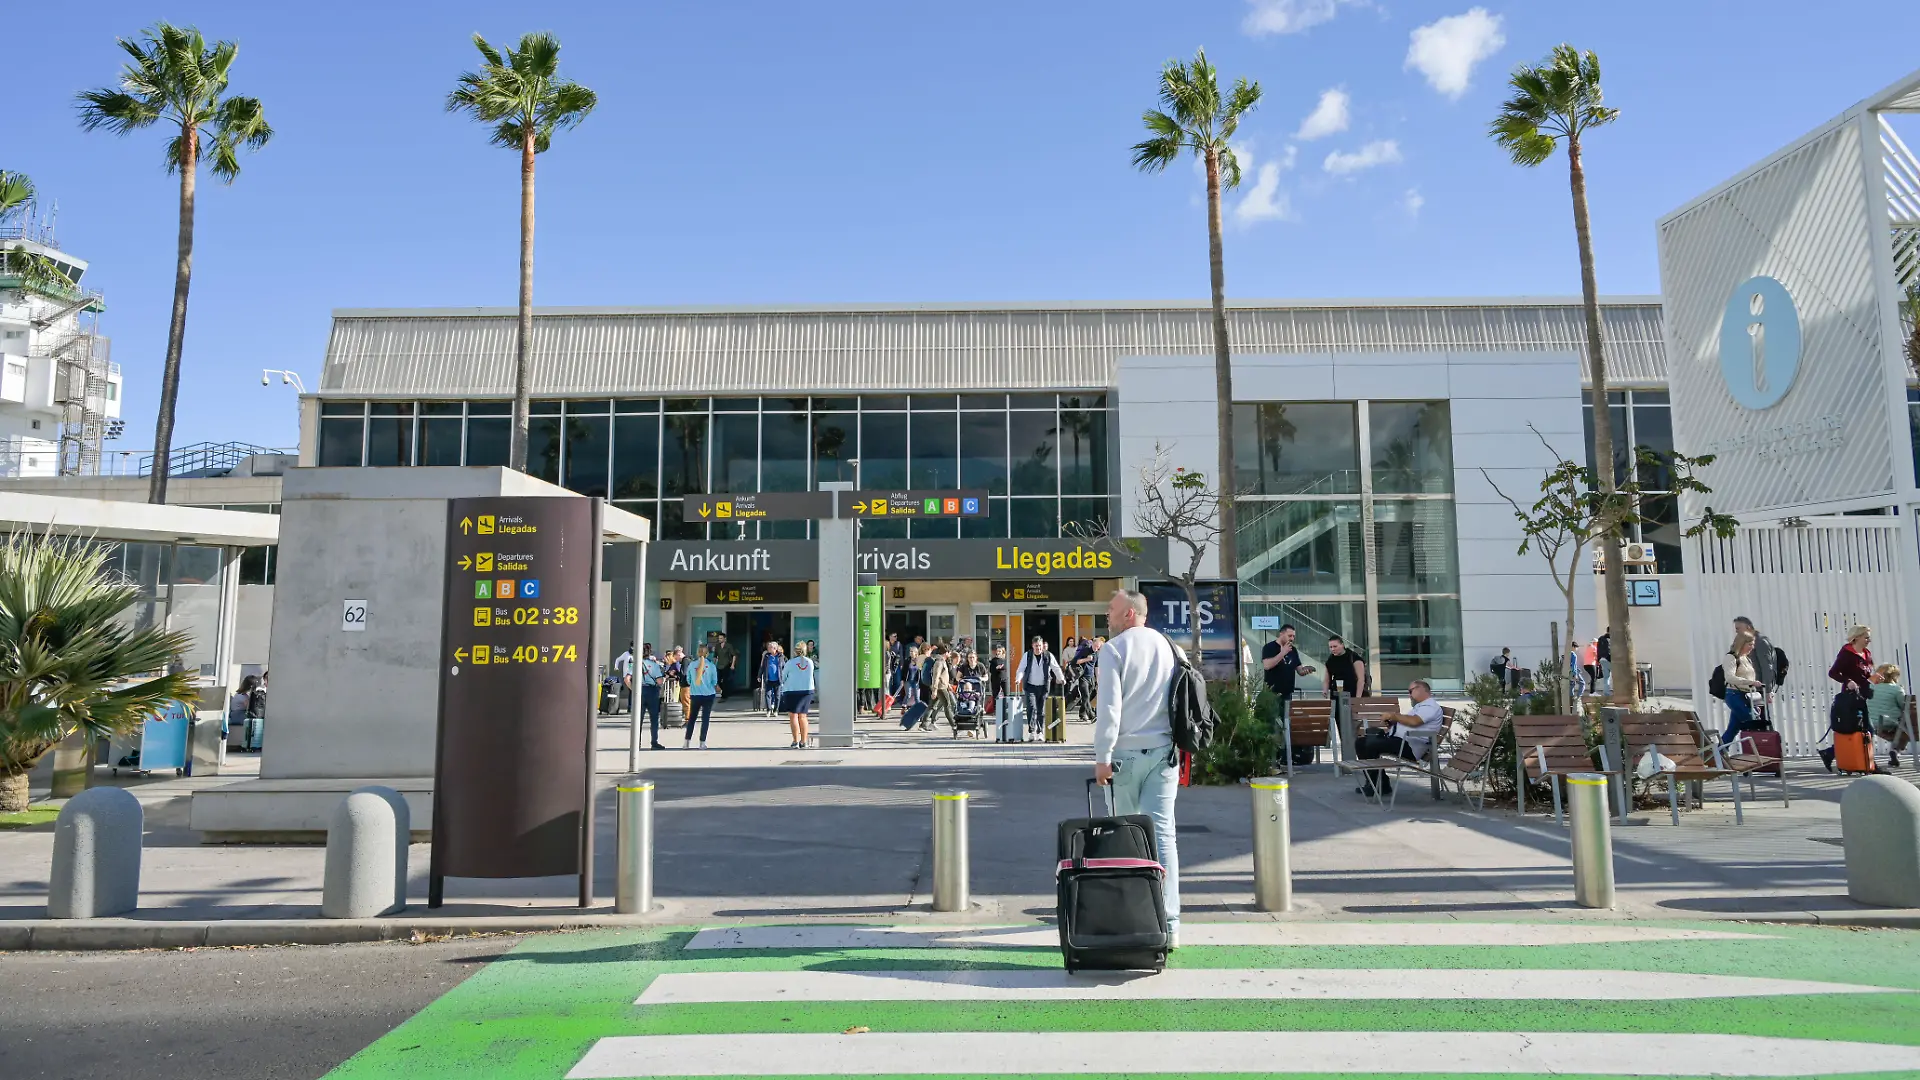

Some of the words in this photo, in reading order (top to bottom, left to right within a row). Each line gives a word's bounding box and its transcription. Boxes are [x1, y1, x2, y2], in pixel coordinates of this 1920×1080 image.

[928, 501, 936, 512] A
[948, 501, 955, 511] B
[966, 500, 975, 511] C
[498, 525, 537, 534] Llegadas
[497, 553, 534, 561] Departures
[670, 548, 770, 571] Ankunft
[857, 547, 931, 570] rrivals
[997, 546, 1112, 575] Llegadas
[497, 562, 528, 571] Salidas
[479, 584, 488, 596] A
[501, 583, 511, 595] B
[524, 582, 535, 595] C
[345, 606, 364, 622] 62
[513, 607, 539, 625] 02
[553, 607, 578, 624] 38
[512, 645, 538, 663] 40
[552, 645, 577, 663] 74
